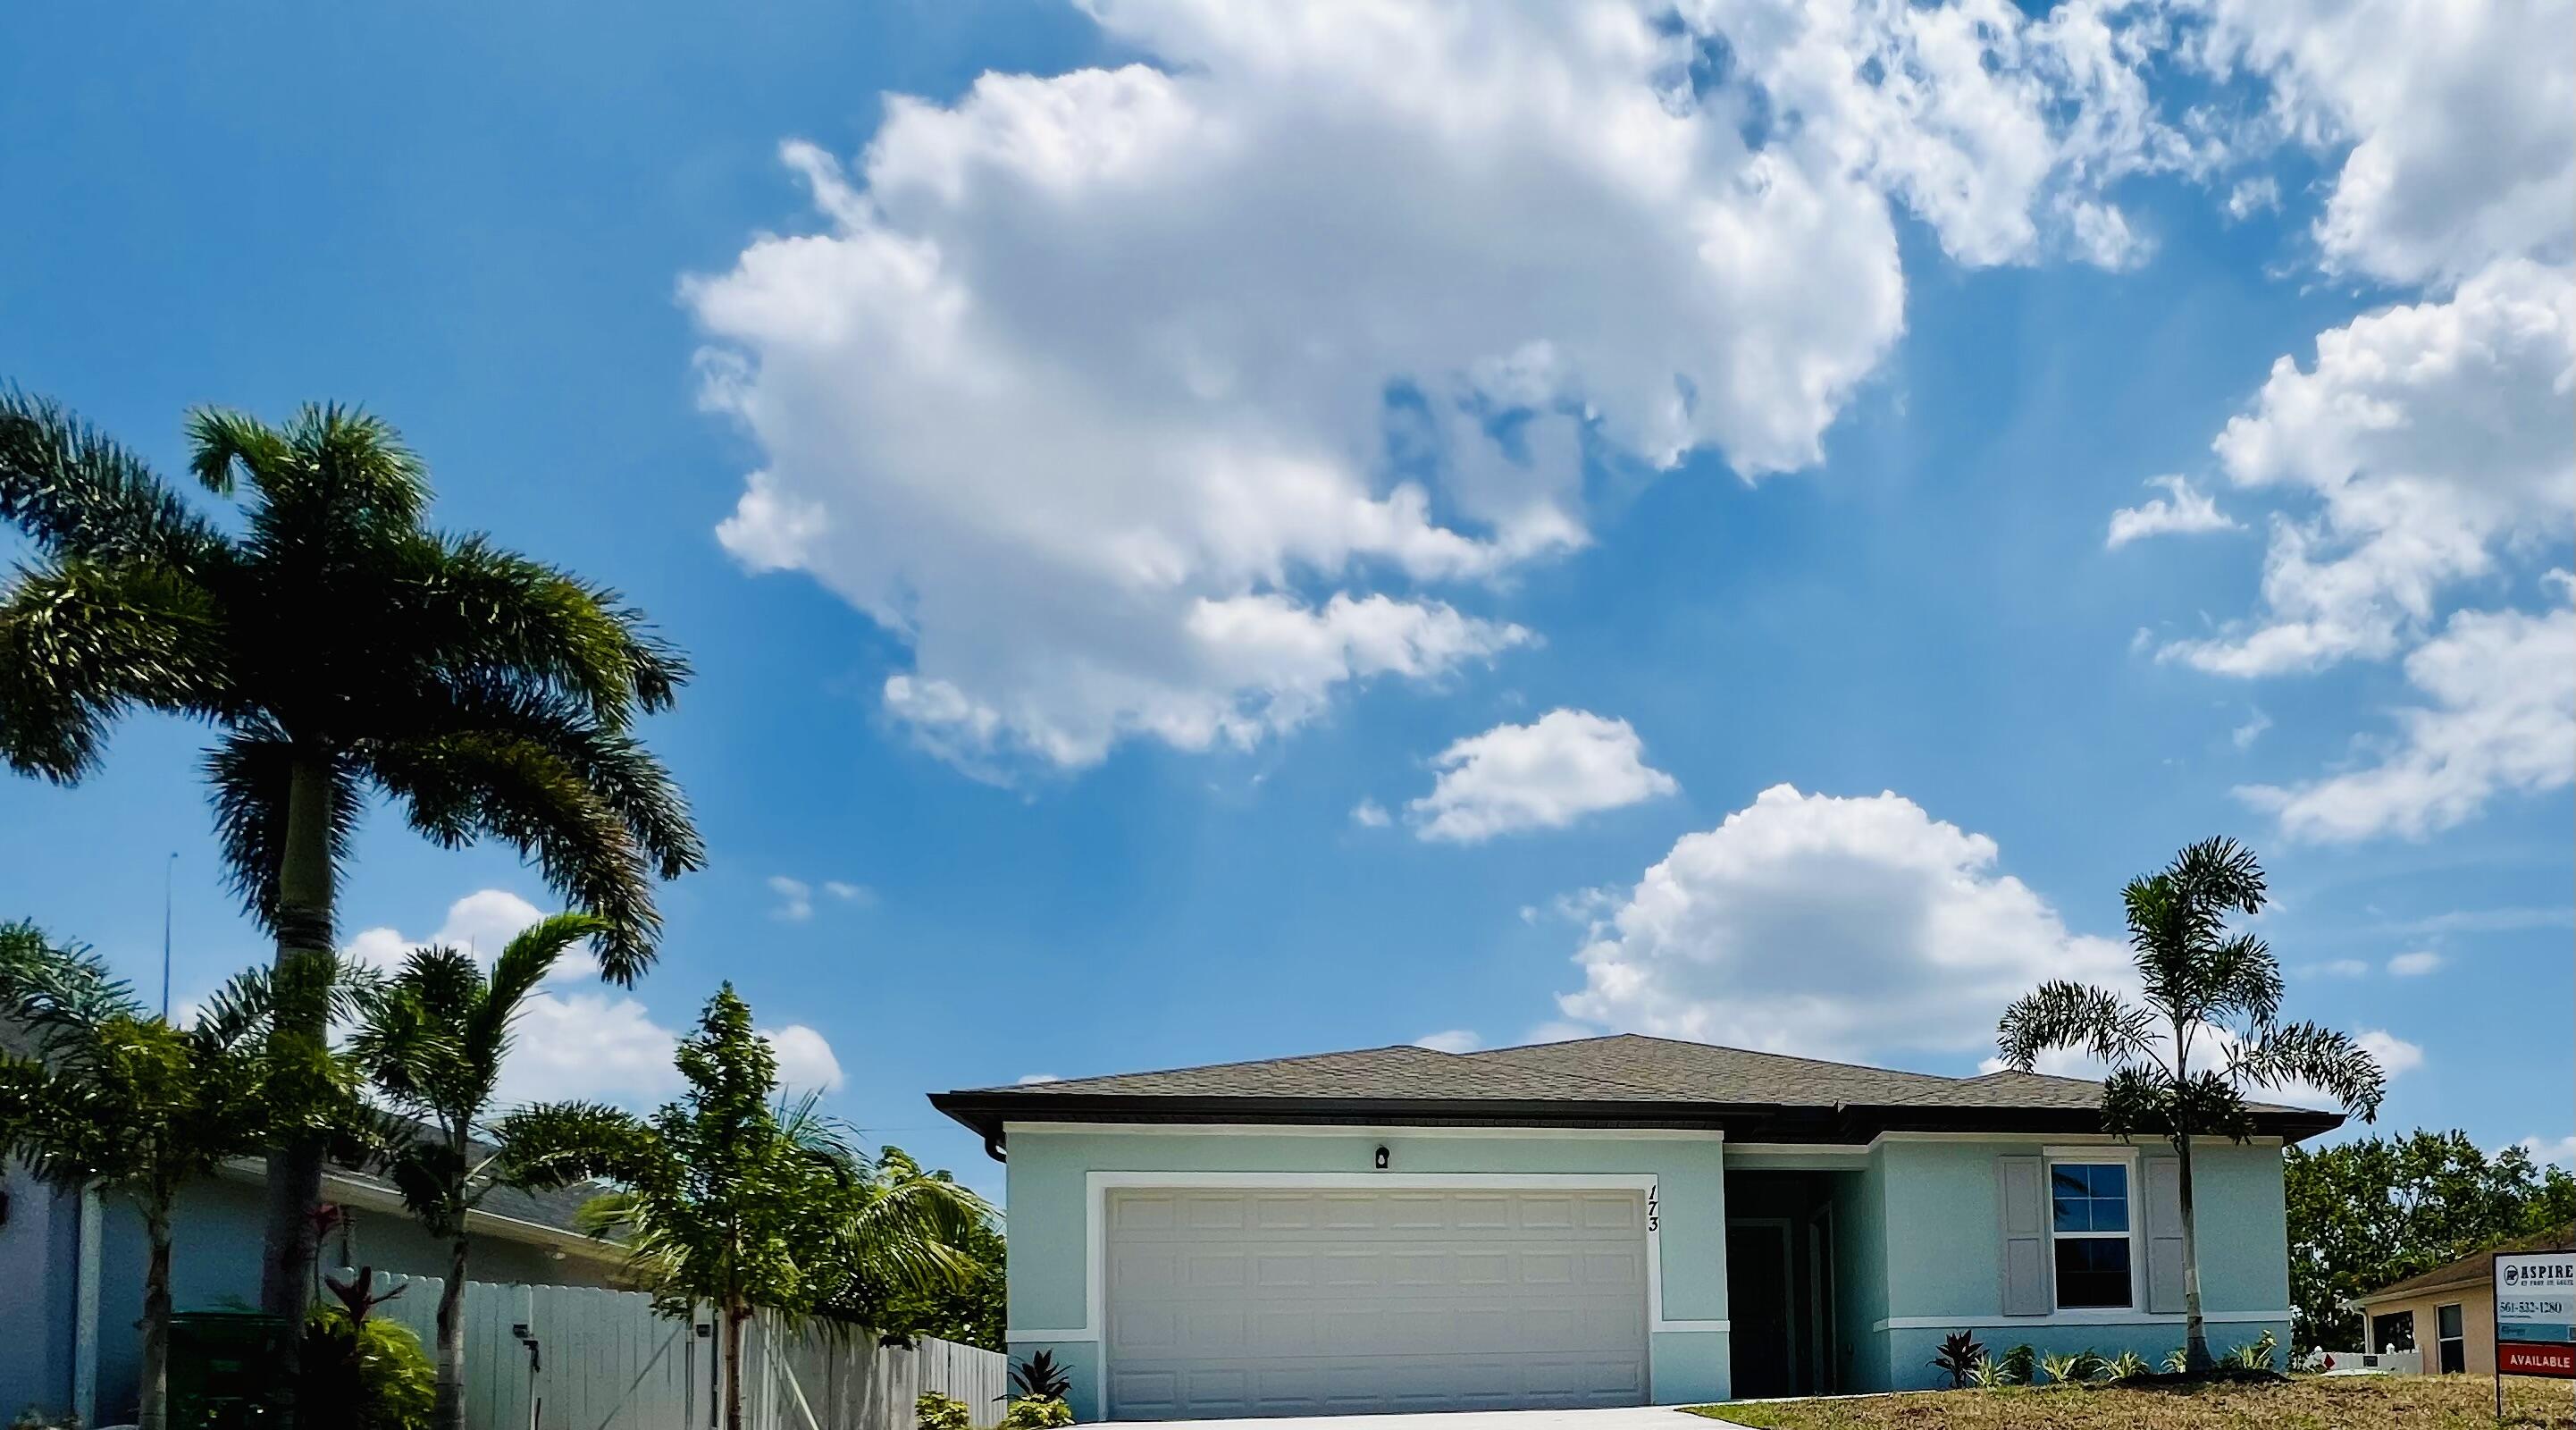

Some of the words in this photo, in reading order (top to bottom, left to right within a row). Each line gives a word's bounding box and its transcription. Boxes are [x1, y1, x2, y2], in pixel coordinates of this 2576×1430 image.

[1649, 1185, 1658, 1232] 173
[2521, 1265, 2573, 1278] ASPIRE
[2500, 1301, 2562, 1313] 561-532-1280
[2510, 1354, 2571, 1368] AVAILABLE
